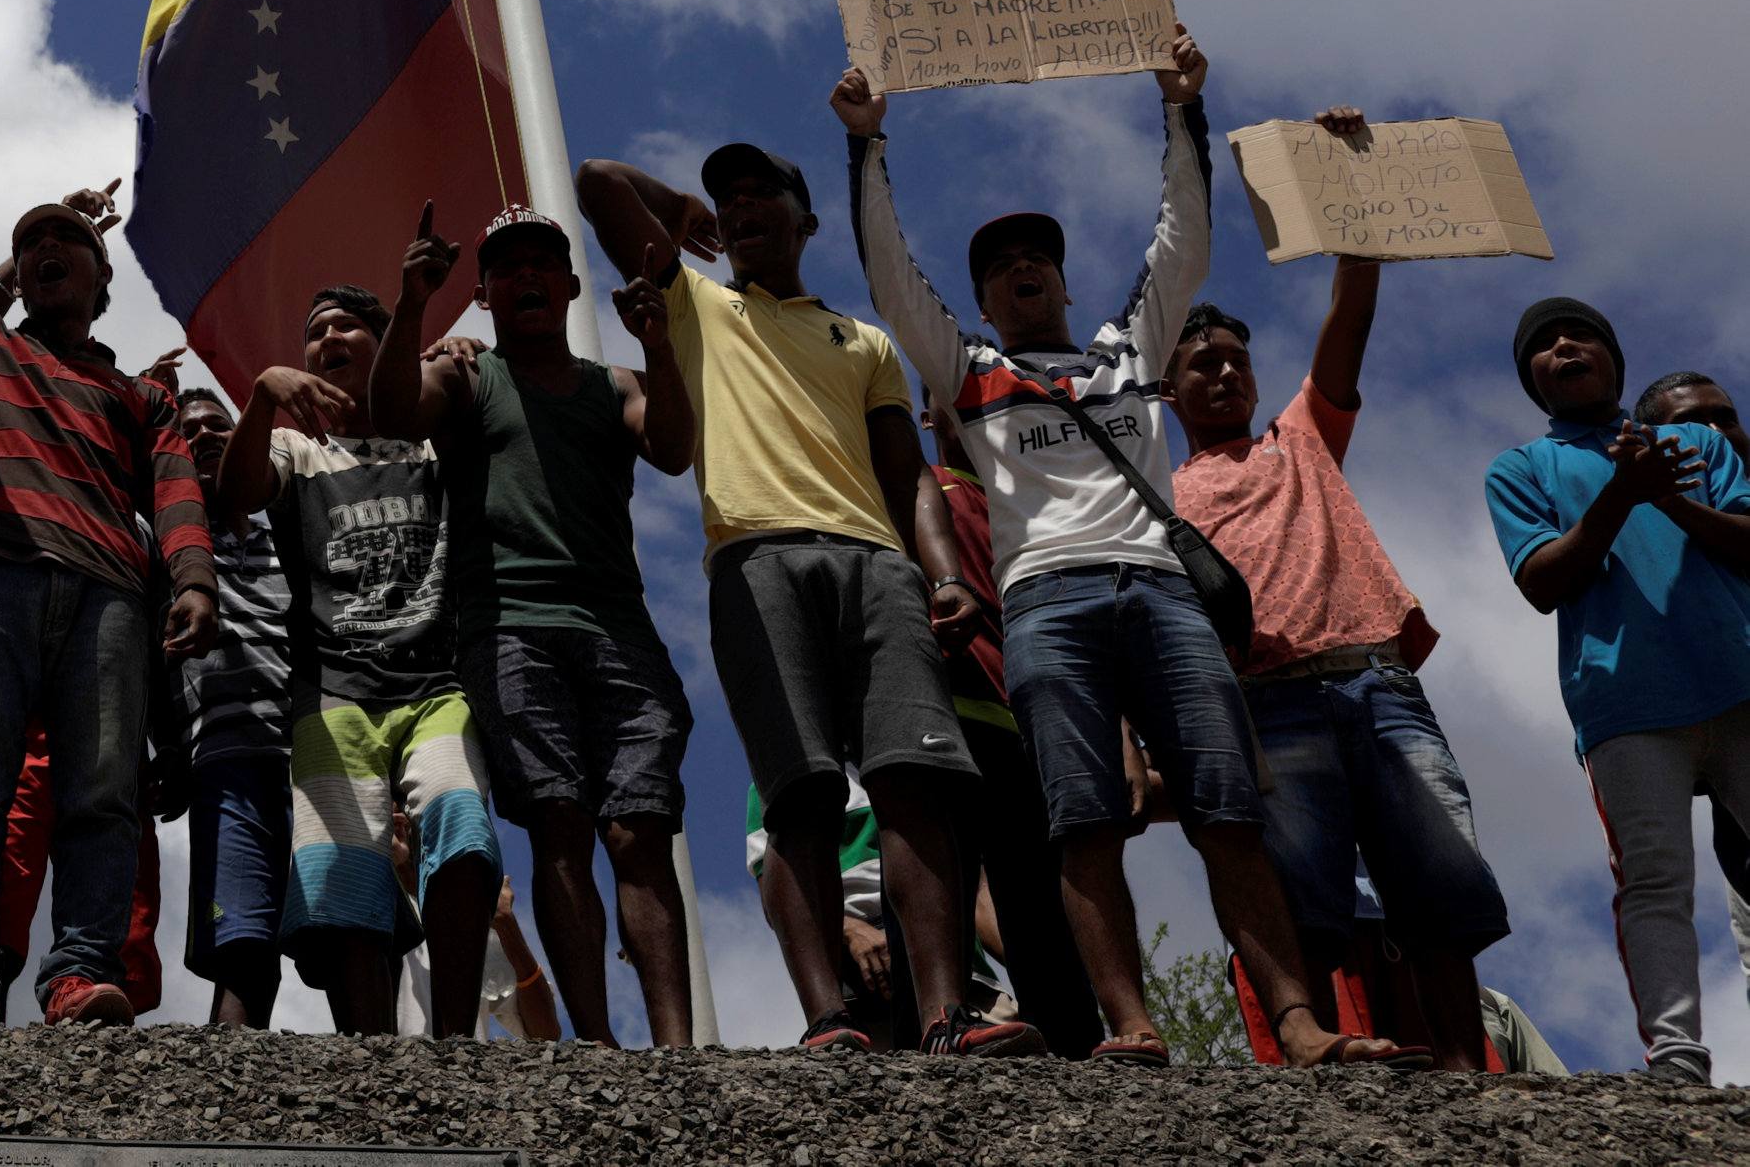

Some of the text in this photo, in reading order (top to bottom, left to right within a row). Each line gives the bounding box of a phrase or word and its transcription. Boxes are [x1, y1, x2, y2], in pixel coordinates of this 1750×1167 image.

[928, 1, 957, 17] TU
[956, 29, 973, 47] A
[986, 23, 1018, 46] LA
[1327, 223, 1369, 245] TU
[1018, 414, 1143, 454] HILFIER
